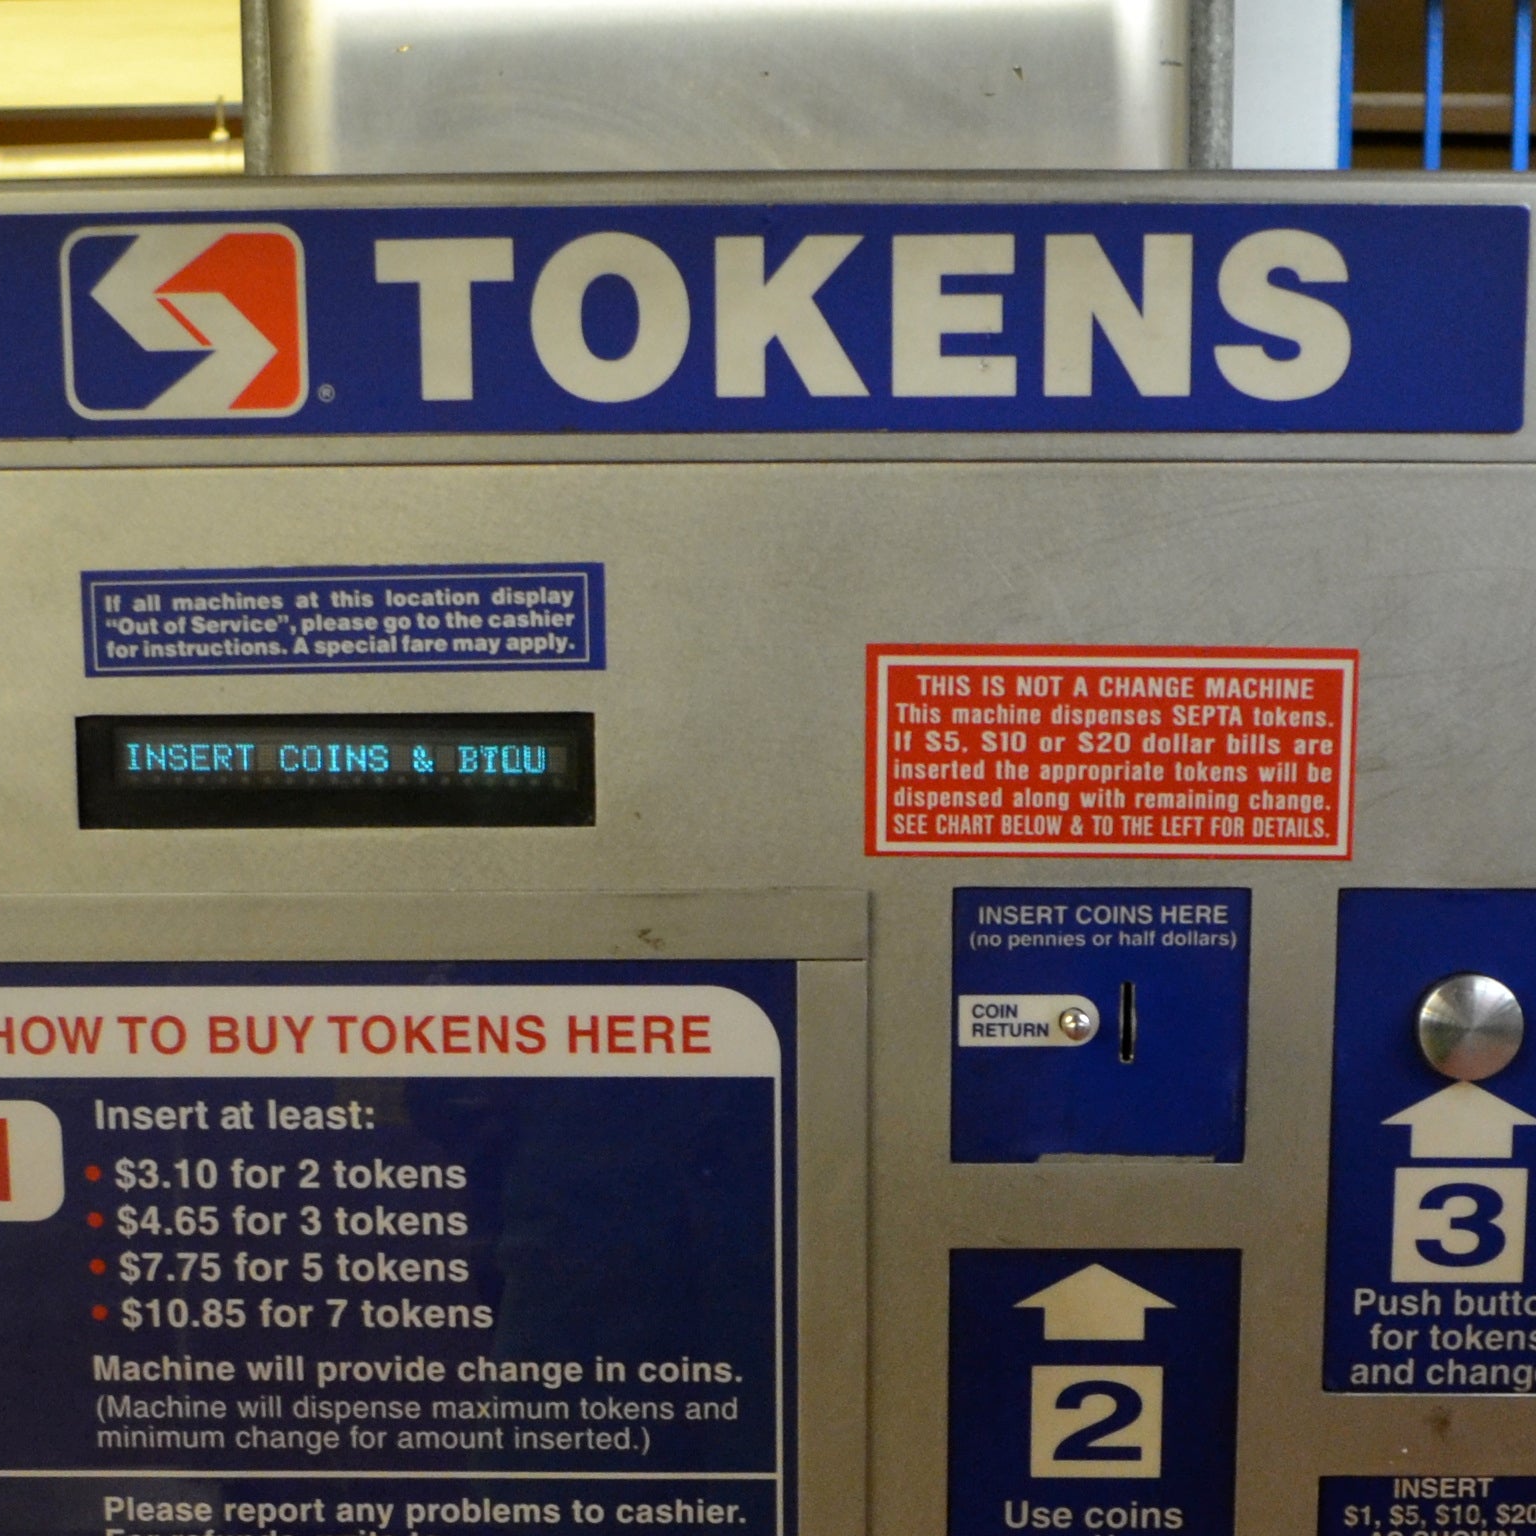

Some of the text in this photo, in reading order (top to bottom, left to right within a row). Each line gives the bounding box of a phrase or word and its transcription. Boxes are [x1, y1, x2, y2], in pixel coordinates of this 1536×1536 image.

[375, 229, 1351, 403] TOKENS
[133, 587, 574, 612] all machines at this location display
[164, 609, 575, 635] of please go to the cashier
[106, 633, 575, 658] for instructions. special fare may apply.
[917, 675, 1314, 699] THIS NOT CHANGE MACHINE
[896, 703, 1333, 728] This machine dispenses SEPTA tokens.
[981, 731, 1333, 755] $10 or $20 dollar bills are
[127, 744, 389, 772] INSERT COINS
[894, 759, 1332, 784] inserted the appropriate tokens will be
[894, 787, 1330, 814] dispensed along with remaining change.
[894, 813, 1329, 838] SEE CHART BELOW THE LEFT FOR DETAILS.
[979, 905, 1228, 925] INSERT COINS HERE
[970, 930, 1237, 950] (no pennies or half dollars)
[972, 1004, 1017, 1019] COIN
[117, 1015, 186, 1055] TO
[209, 1016, 314, 1055] BUY
[328, 1015, 546, 1054] TOKENS
[568, 1015, 711, 1054] HERE
[972, 1023, 1049, 1037] RETURN
[95, 1099, 374, 1130] Insert at least:
[115, 1157, 466, 1192] $3.10 for 2 tokens
[117, 1204, 468, 1239] $4.65 for 3 tokens
[1415, 1183, 1506, 1267] 3
[120, 1251, 469, 1285] $7.75 for 5 tokens
[122, 1297, 493, 1330] $10.85 for 7 tokens
[1354, 1288, 1441, 1316] Push
[1370, 1323, 1419, 1350] for
[93, 1355, 742, 1389] Machine will provide change in coins.
[1350, 1358, 1414, 1385] and
[97, 1395, 737, 1424] (Machine will dispense maximum tokens and
[1053, 1380, 1142, 1461] 2
[97, 1425, 650, 1455] minimum change for amount inserted.)
[1394, 1477, 1494, 1499] INSERT
[104, 1496, 746, 1528] Please report any problems to cashier.
[1005, 1500, 1182, 1529] Use coins
[1344, 1505, 1381, 1528] $1,
[1389, 1504, 1426, 1527] $5,
[1435, 1504, 1487, 1527] $10,
